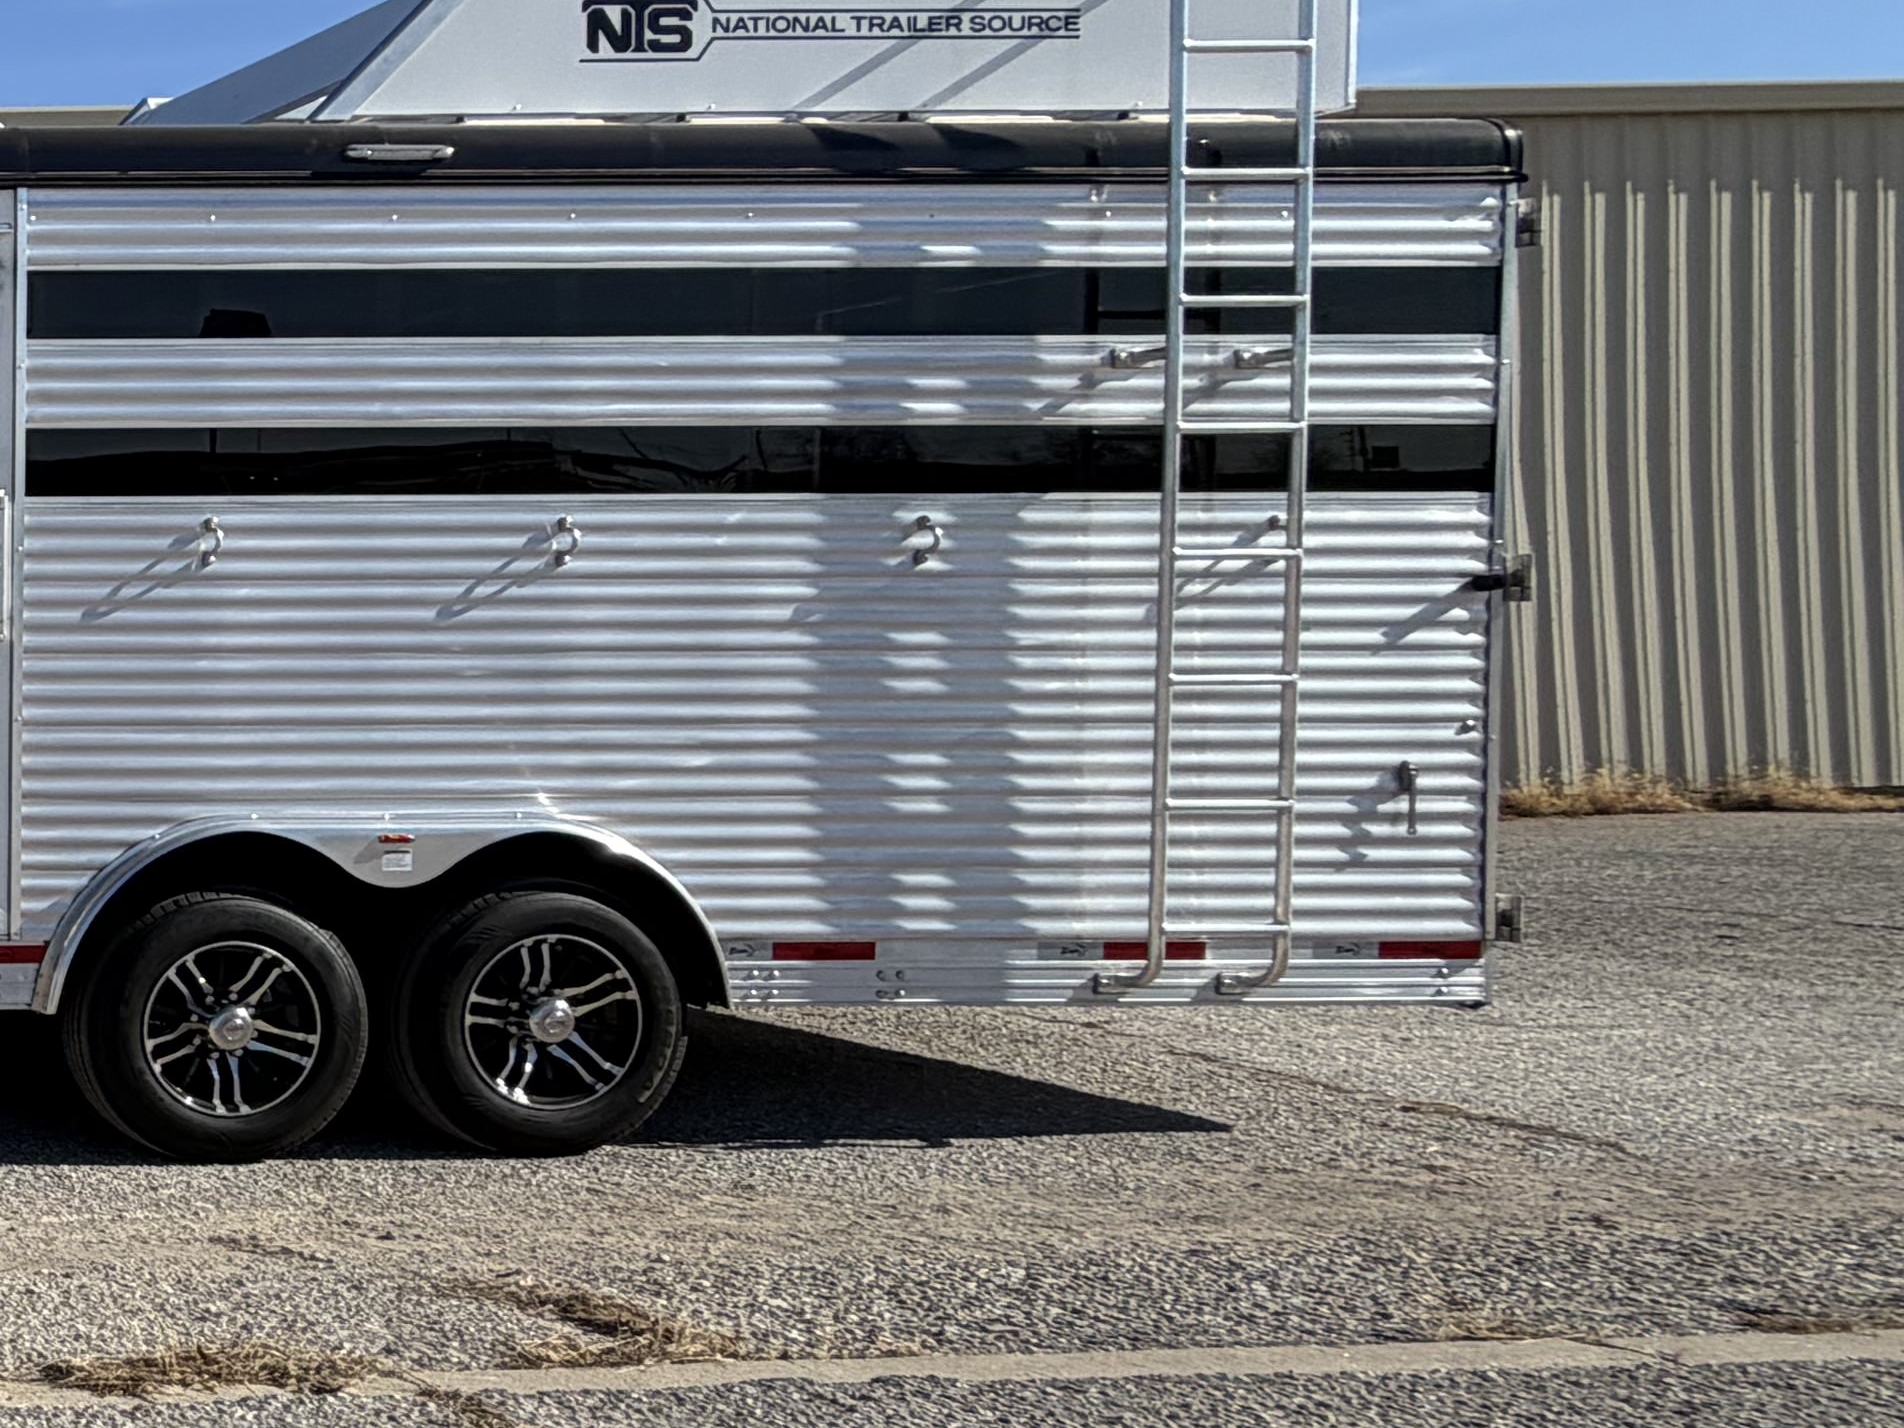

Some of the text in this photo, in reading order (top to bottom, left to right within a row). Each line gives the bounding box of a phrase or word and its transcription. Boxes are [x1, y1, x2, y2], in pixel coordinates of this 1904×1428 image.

[711, 15, 845, 35] NATIONAL
[849, 14, 962, 34] TRAILER
[969, 14, 1080, 34] SOURCE
